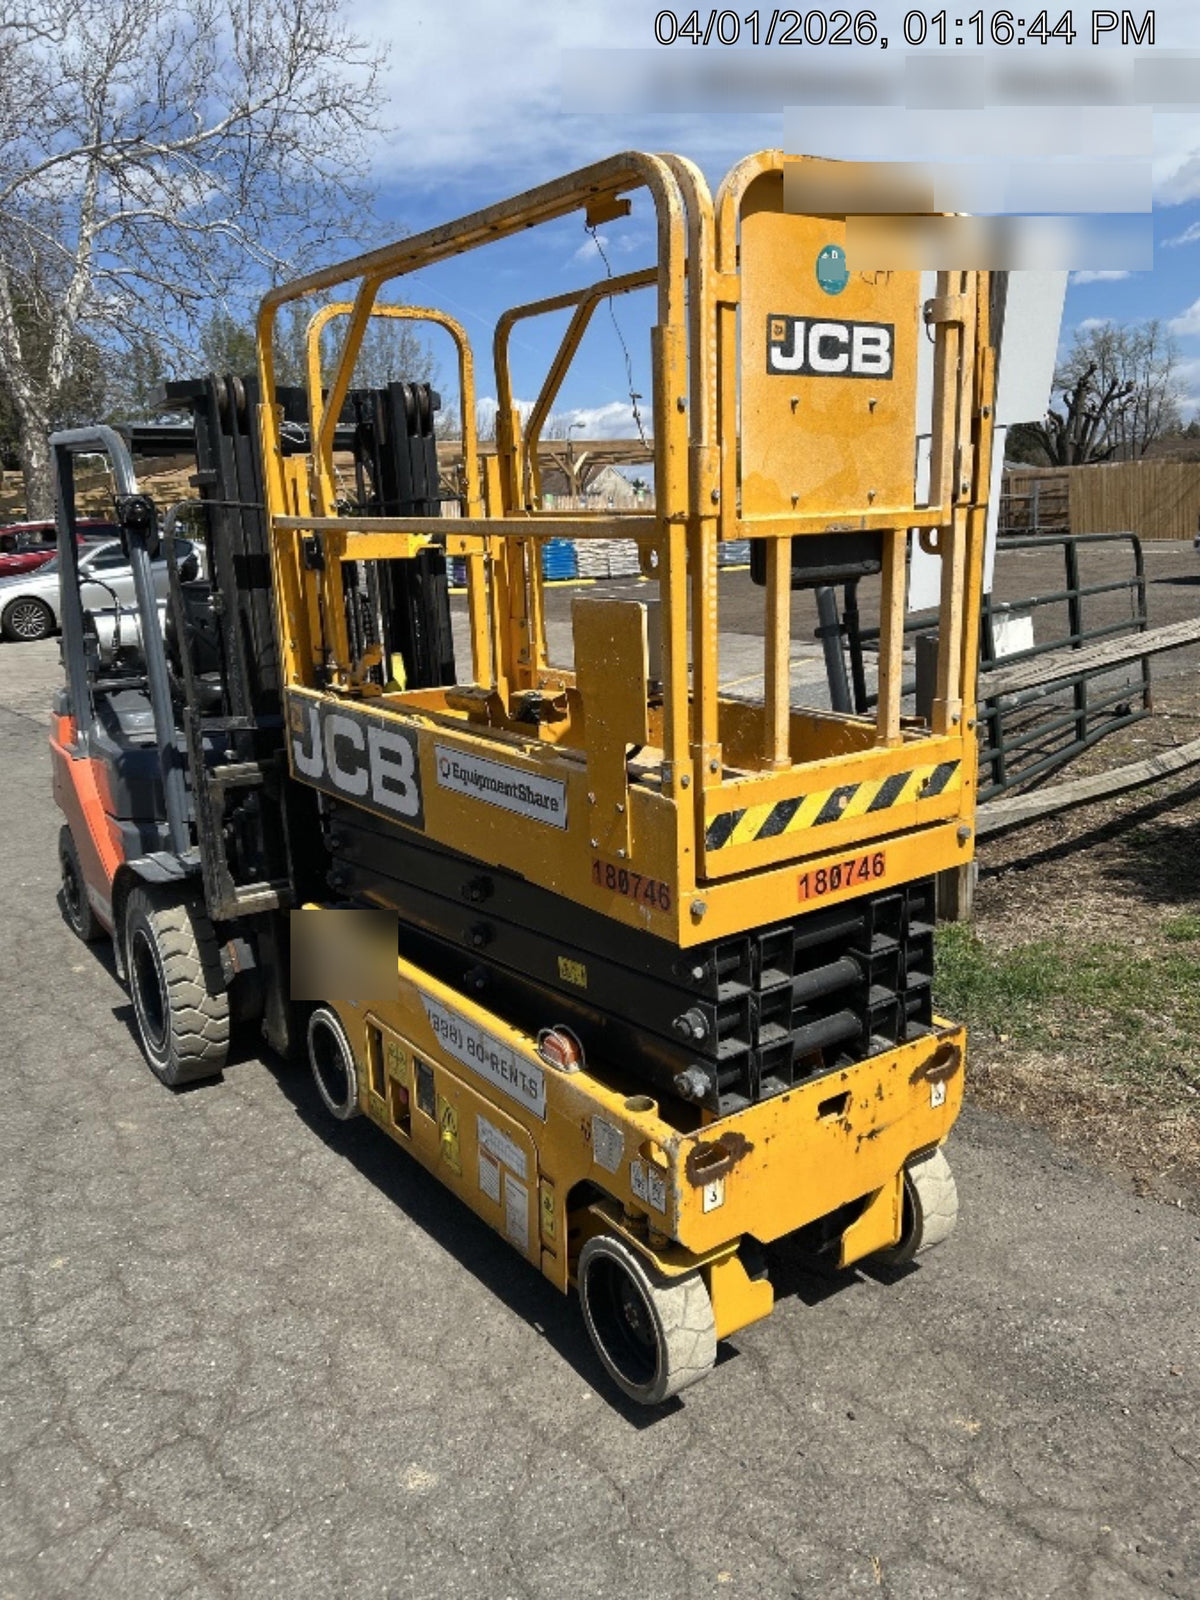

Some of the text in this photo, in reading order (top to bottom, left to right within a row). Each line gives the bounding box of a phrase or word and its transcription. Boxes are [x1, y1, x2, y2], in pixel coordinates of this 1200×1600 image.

[770, 321, 891, 374] JCB
[293, 706, 420, 817] JCB
[452, 761, 559, 812] EquipmentShare
[593, 859, 671, 911] 180746
[800, 852, 885, 898] 180746
[467, 1036, 538, 1100] 80-RENTS
